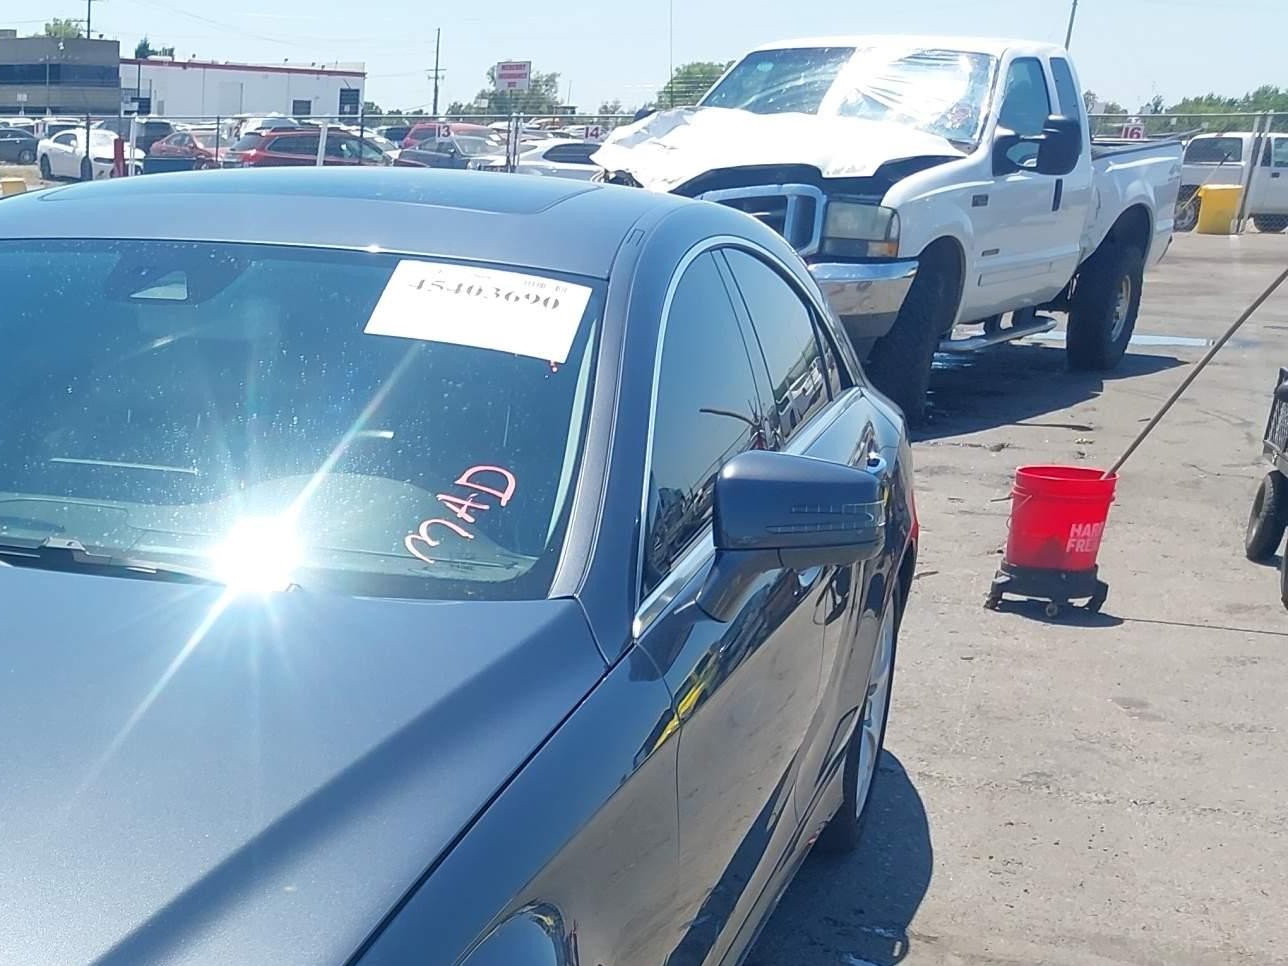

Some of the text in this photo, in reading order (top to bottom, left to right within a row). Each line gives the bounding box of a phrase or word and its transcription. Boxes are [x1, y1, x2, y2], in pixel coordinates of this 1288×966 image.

[437, 125, 451, 137] 13
[585, 126, 599, 139] 14
[1123, 126, 1141, 139] 16
[404, 464, 516, 564] MAD
